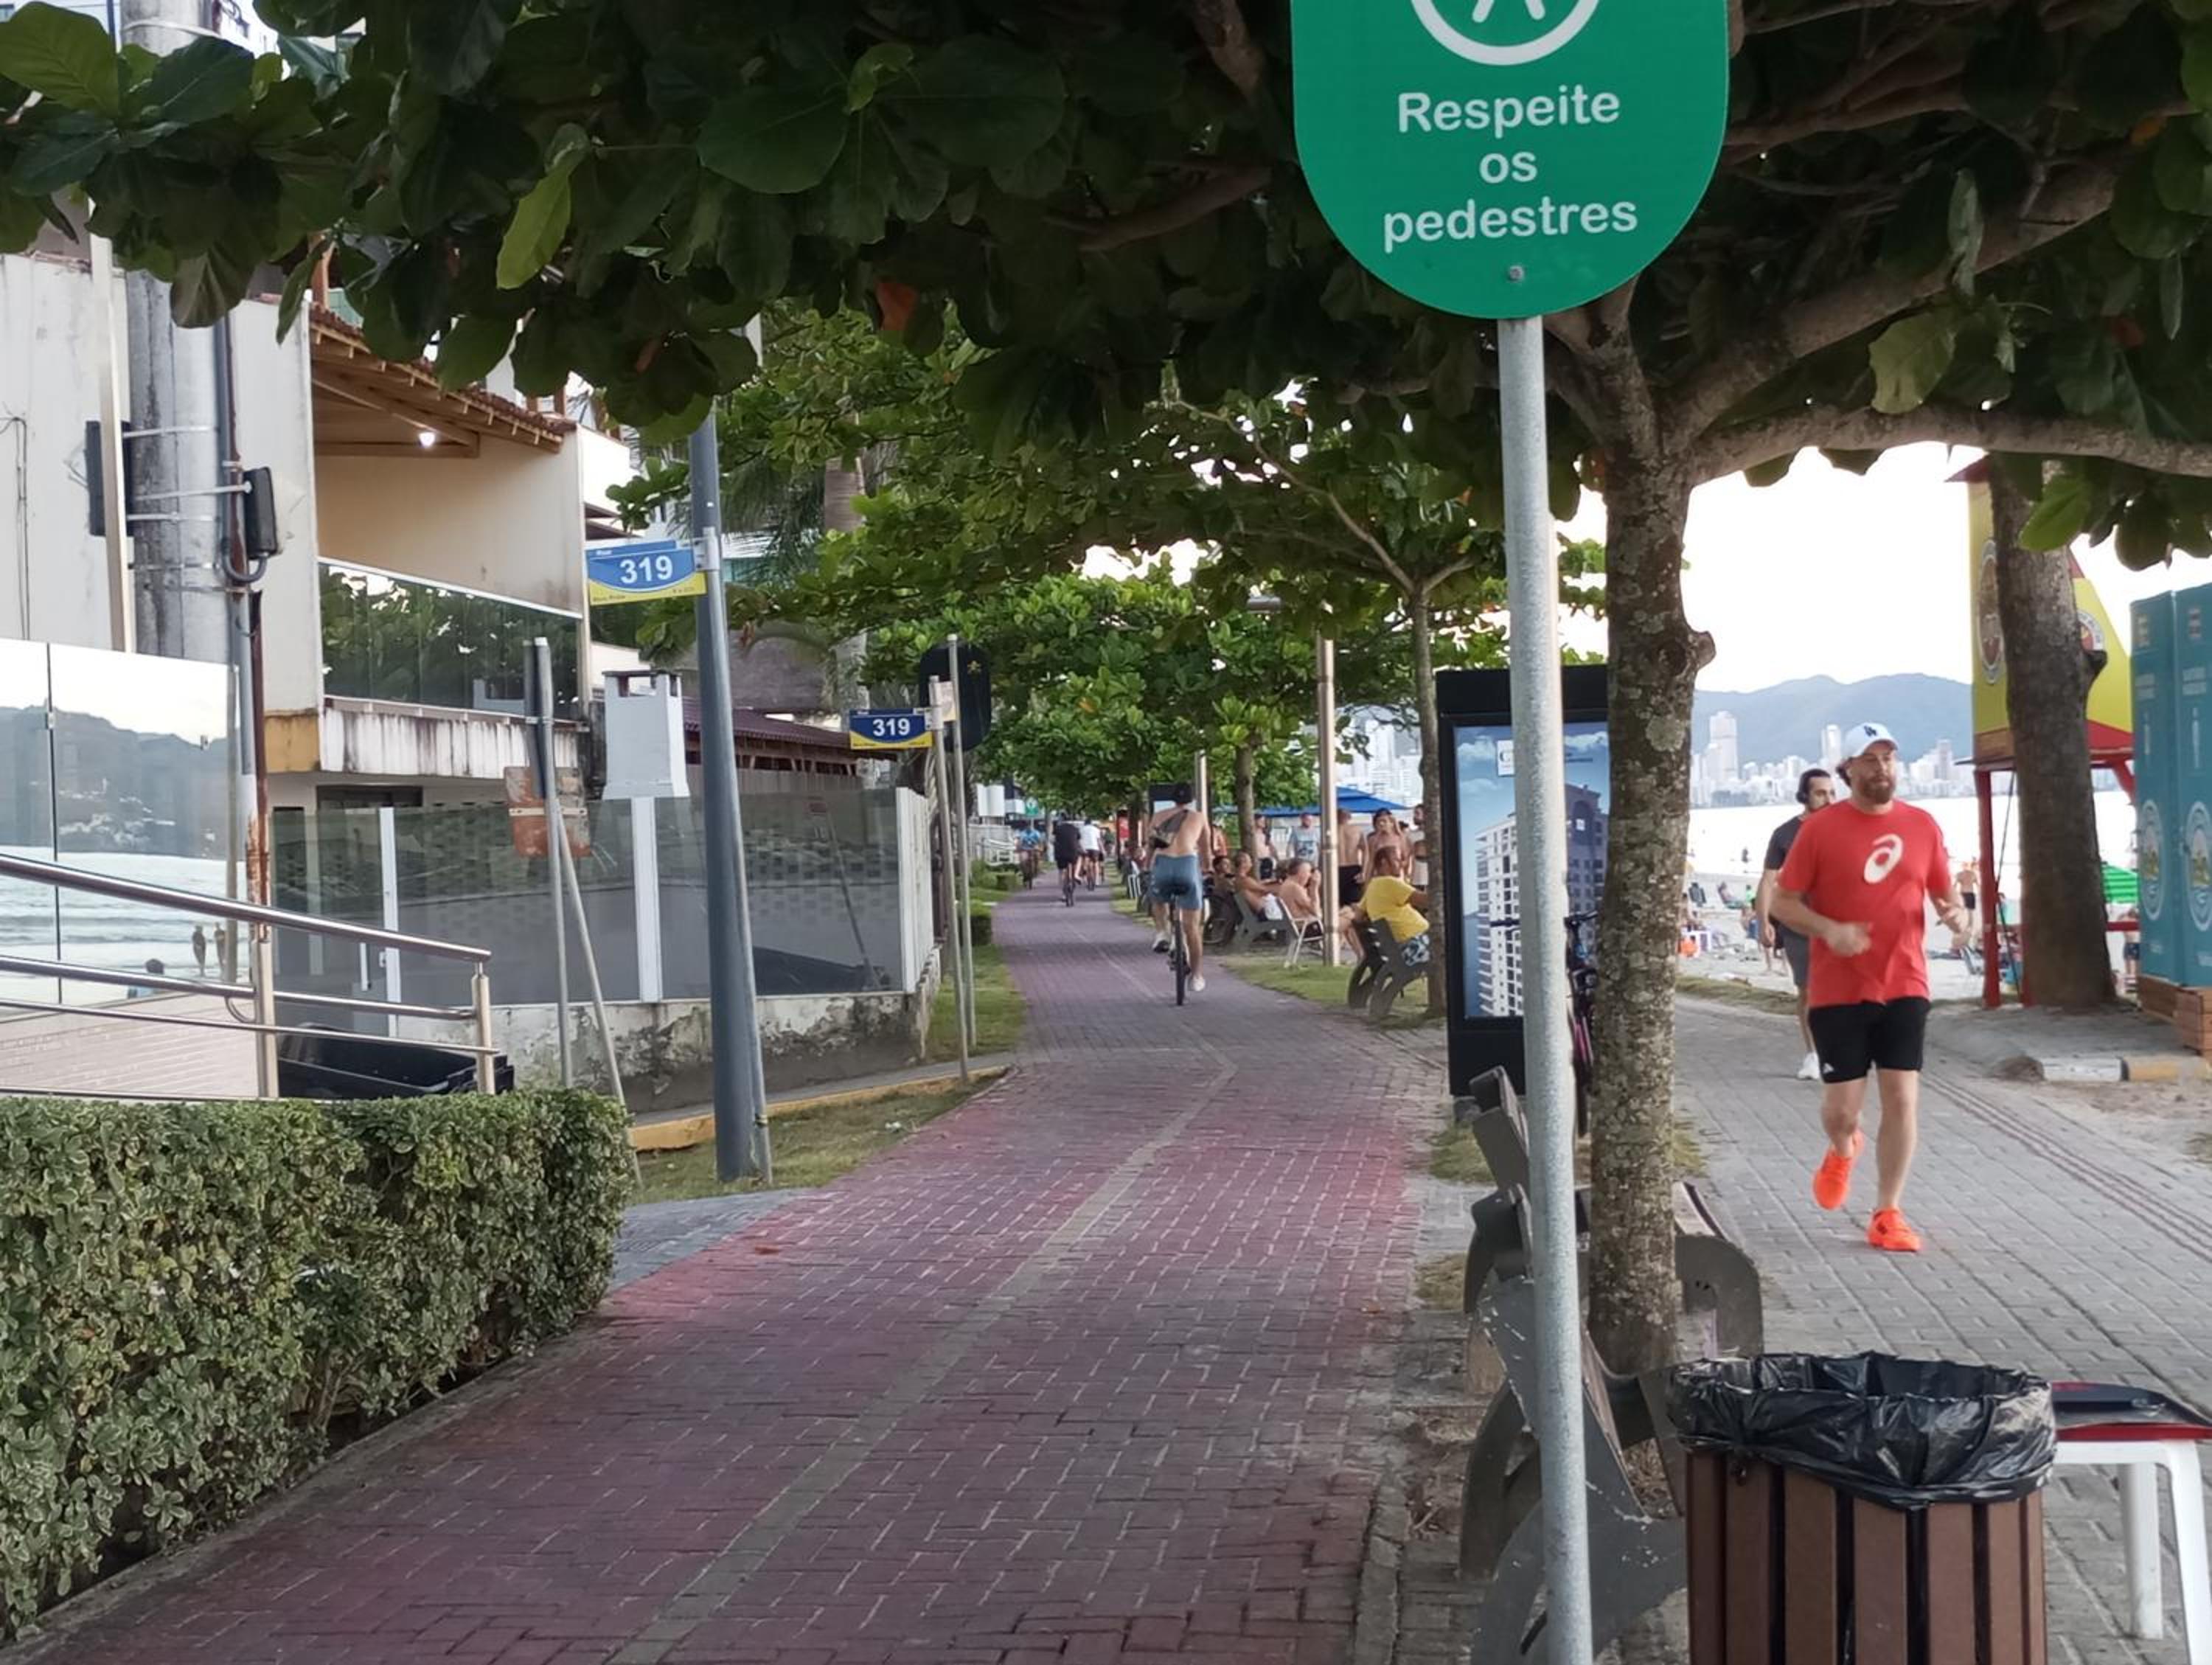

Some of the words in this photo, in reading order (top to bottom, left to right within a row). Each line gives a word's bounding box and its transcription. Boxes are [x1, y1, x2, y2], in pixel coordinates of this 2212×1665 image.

[1398, 84, 1620, 139] Respeite
[1479, 150, 1538, 184] os
[1383, 195, 1638, 254] pedestres
[619, 555, 673, 584] 319
[872, 717, 911, 737] 319
